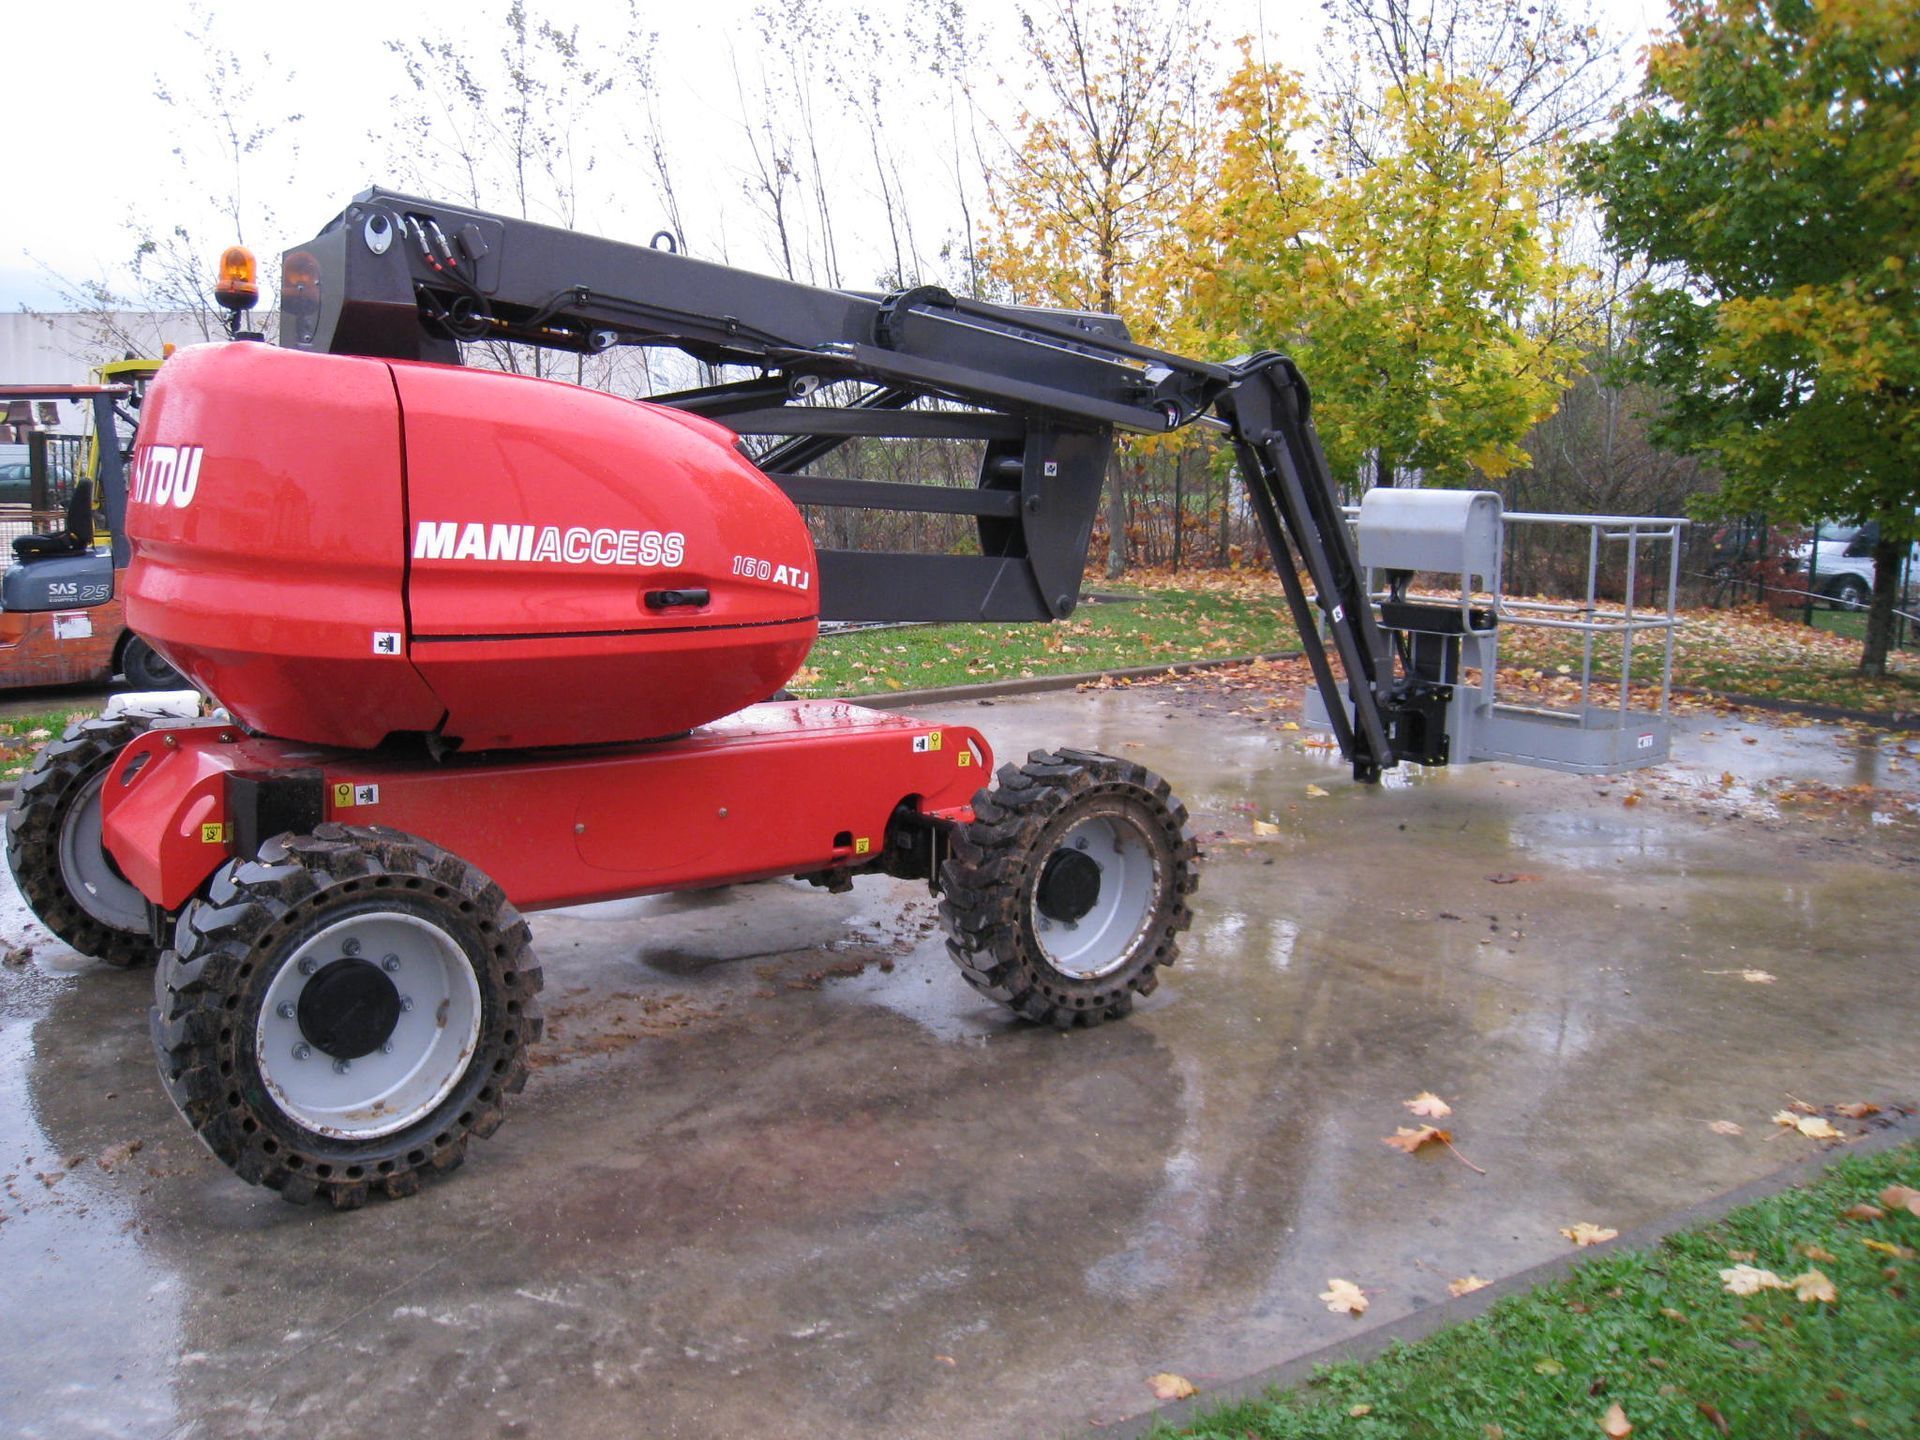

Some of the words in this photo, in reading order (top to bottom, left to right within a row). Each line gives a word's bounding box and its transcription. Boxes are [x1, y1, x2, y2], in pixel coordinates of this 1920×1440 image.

[733, 555, 771, 580] 160
[773, 564, 809, 590] ATJ
[49, 583, 78, 595] SAS
[80, 584, 109, 600] 25
